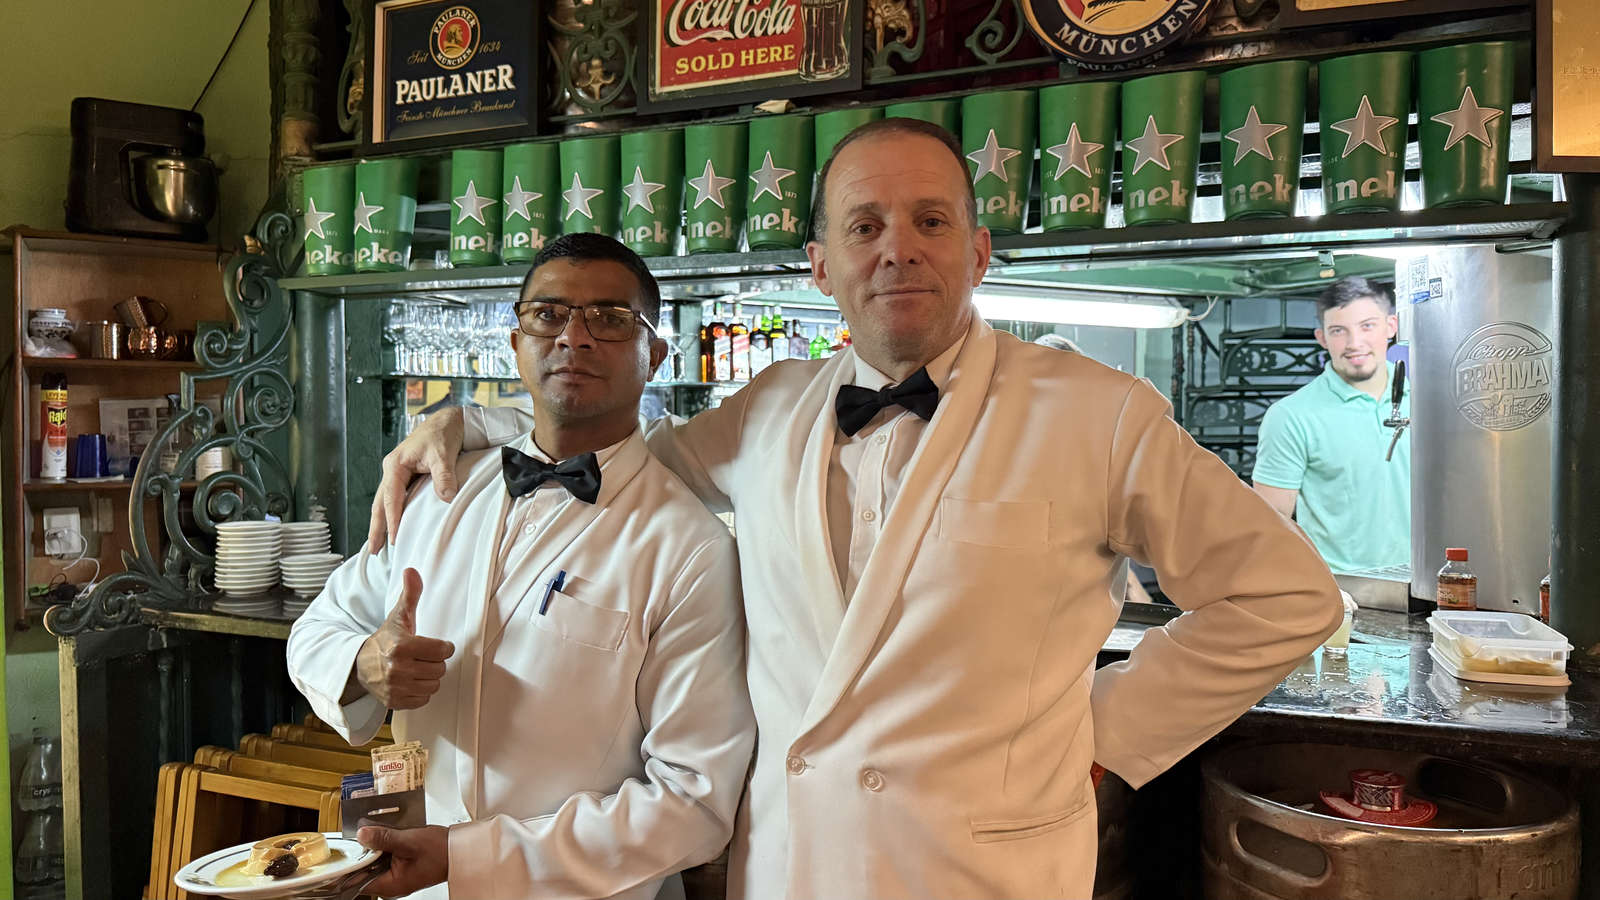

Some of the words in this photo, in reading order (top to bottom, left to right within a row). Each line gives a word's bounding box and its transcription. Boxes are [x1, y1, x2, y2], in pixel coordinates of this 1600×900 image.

[433, 9, 476, 35] PAULANER
[1054, 0, 1198, 56] MÜNCHEN
[436, 48, 472, 66] MÜNCHEN
[675, 52, 735, 75] SOLD
[740, 44, 796, 67] HERE
[395, 64, 516, 105] PAULANER
[1471, 344, 1530, 361] Chopp
[1459, 358, 1550, 392] BRAHMA
